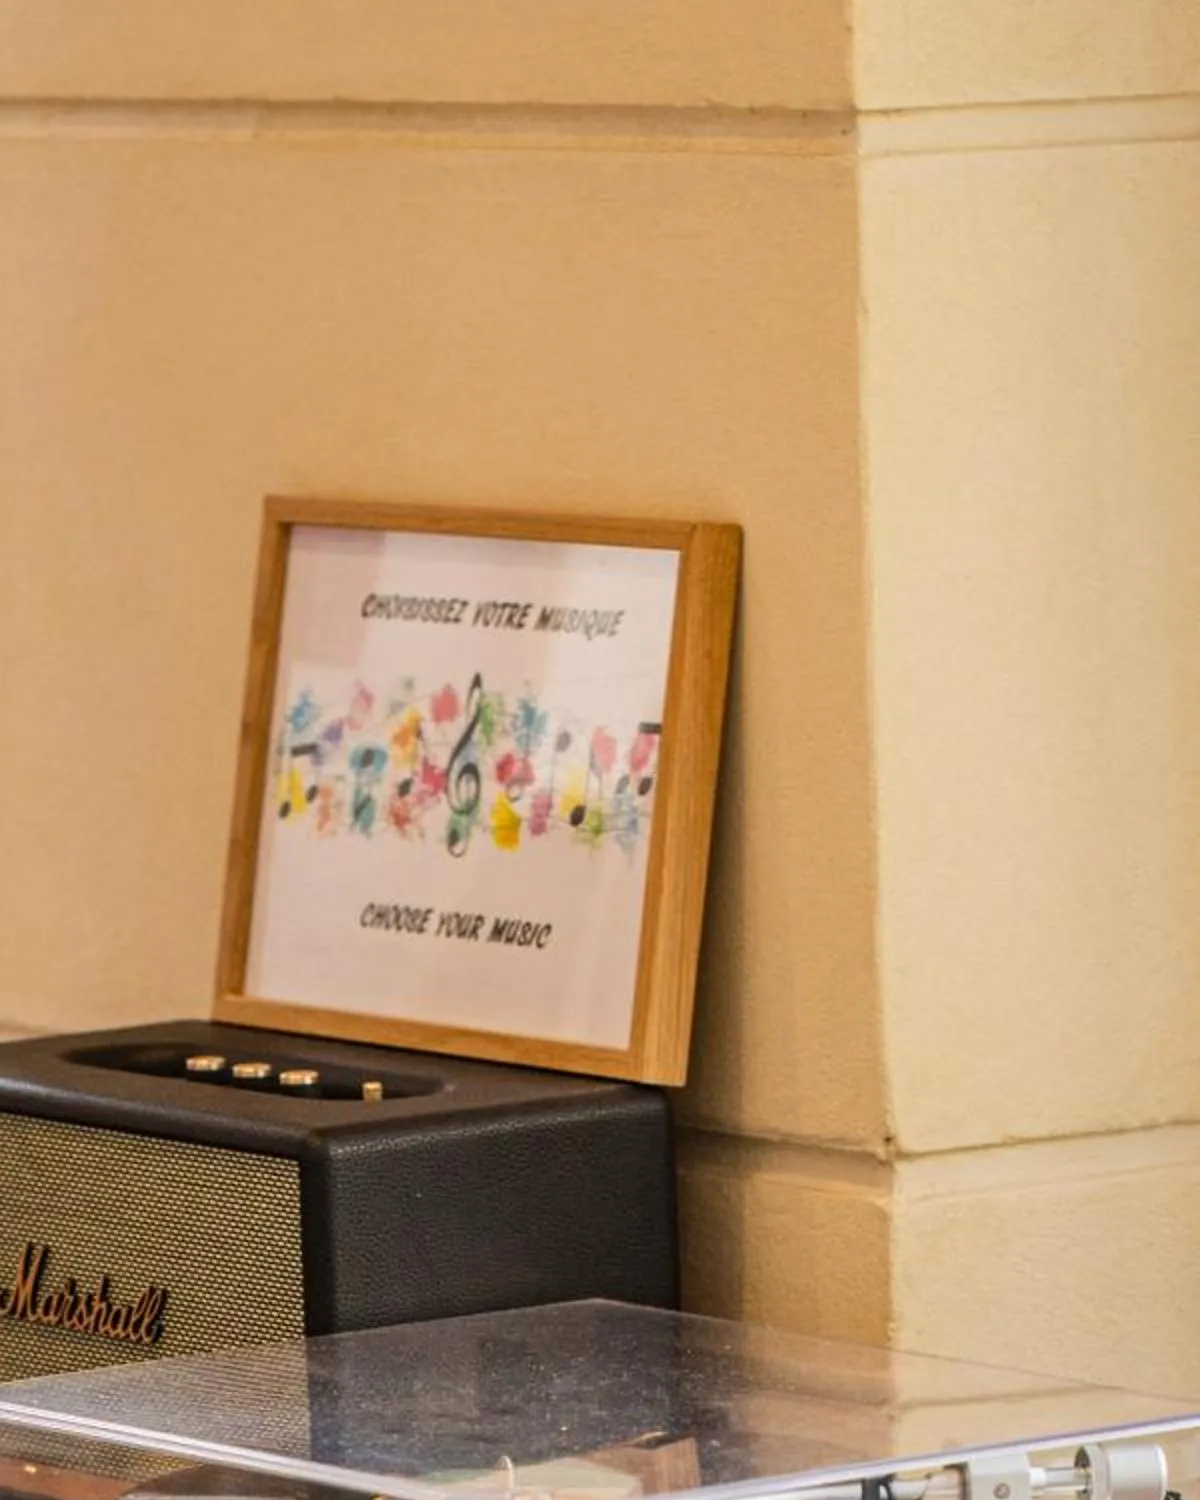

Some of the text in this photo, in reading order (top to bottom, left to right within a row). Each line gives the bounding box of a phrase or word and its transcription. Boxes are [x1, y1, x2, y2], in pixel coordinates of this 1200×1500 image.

[471, 599, 534, 630] VOTRE
[534, 604, 625, 641] MUSIQUE
[360, 902, 553, 949] CHOOSE YOUR MUSIC
